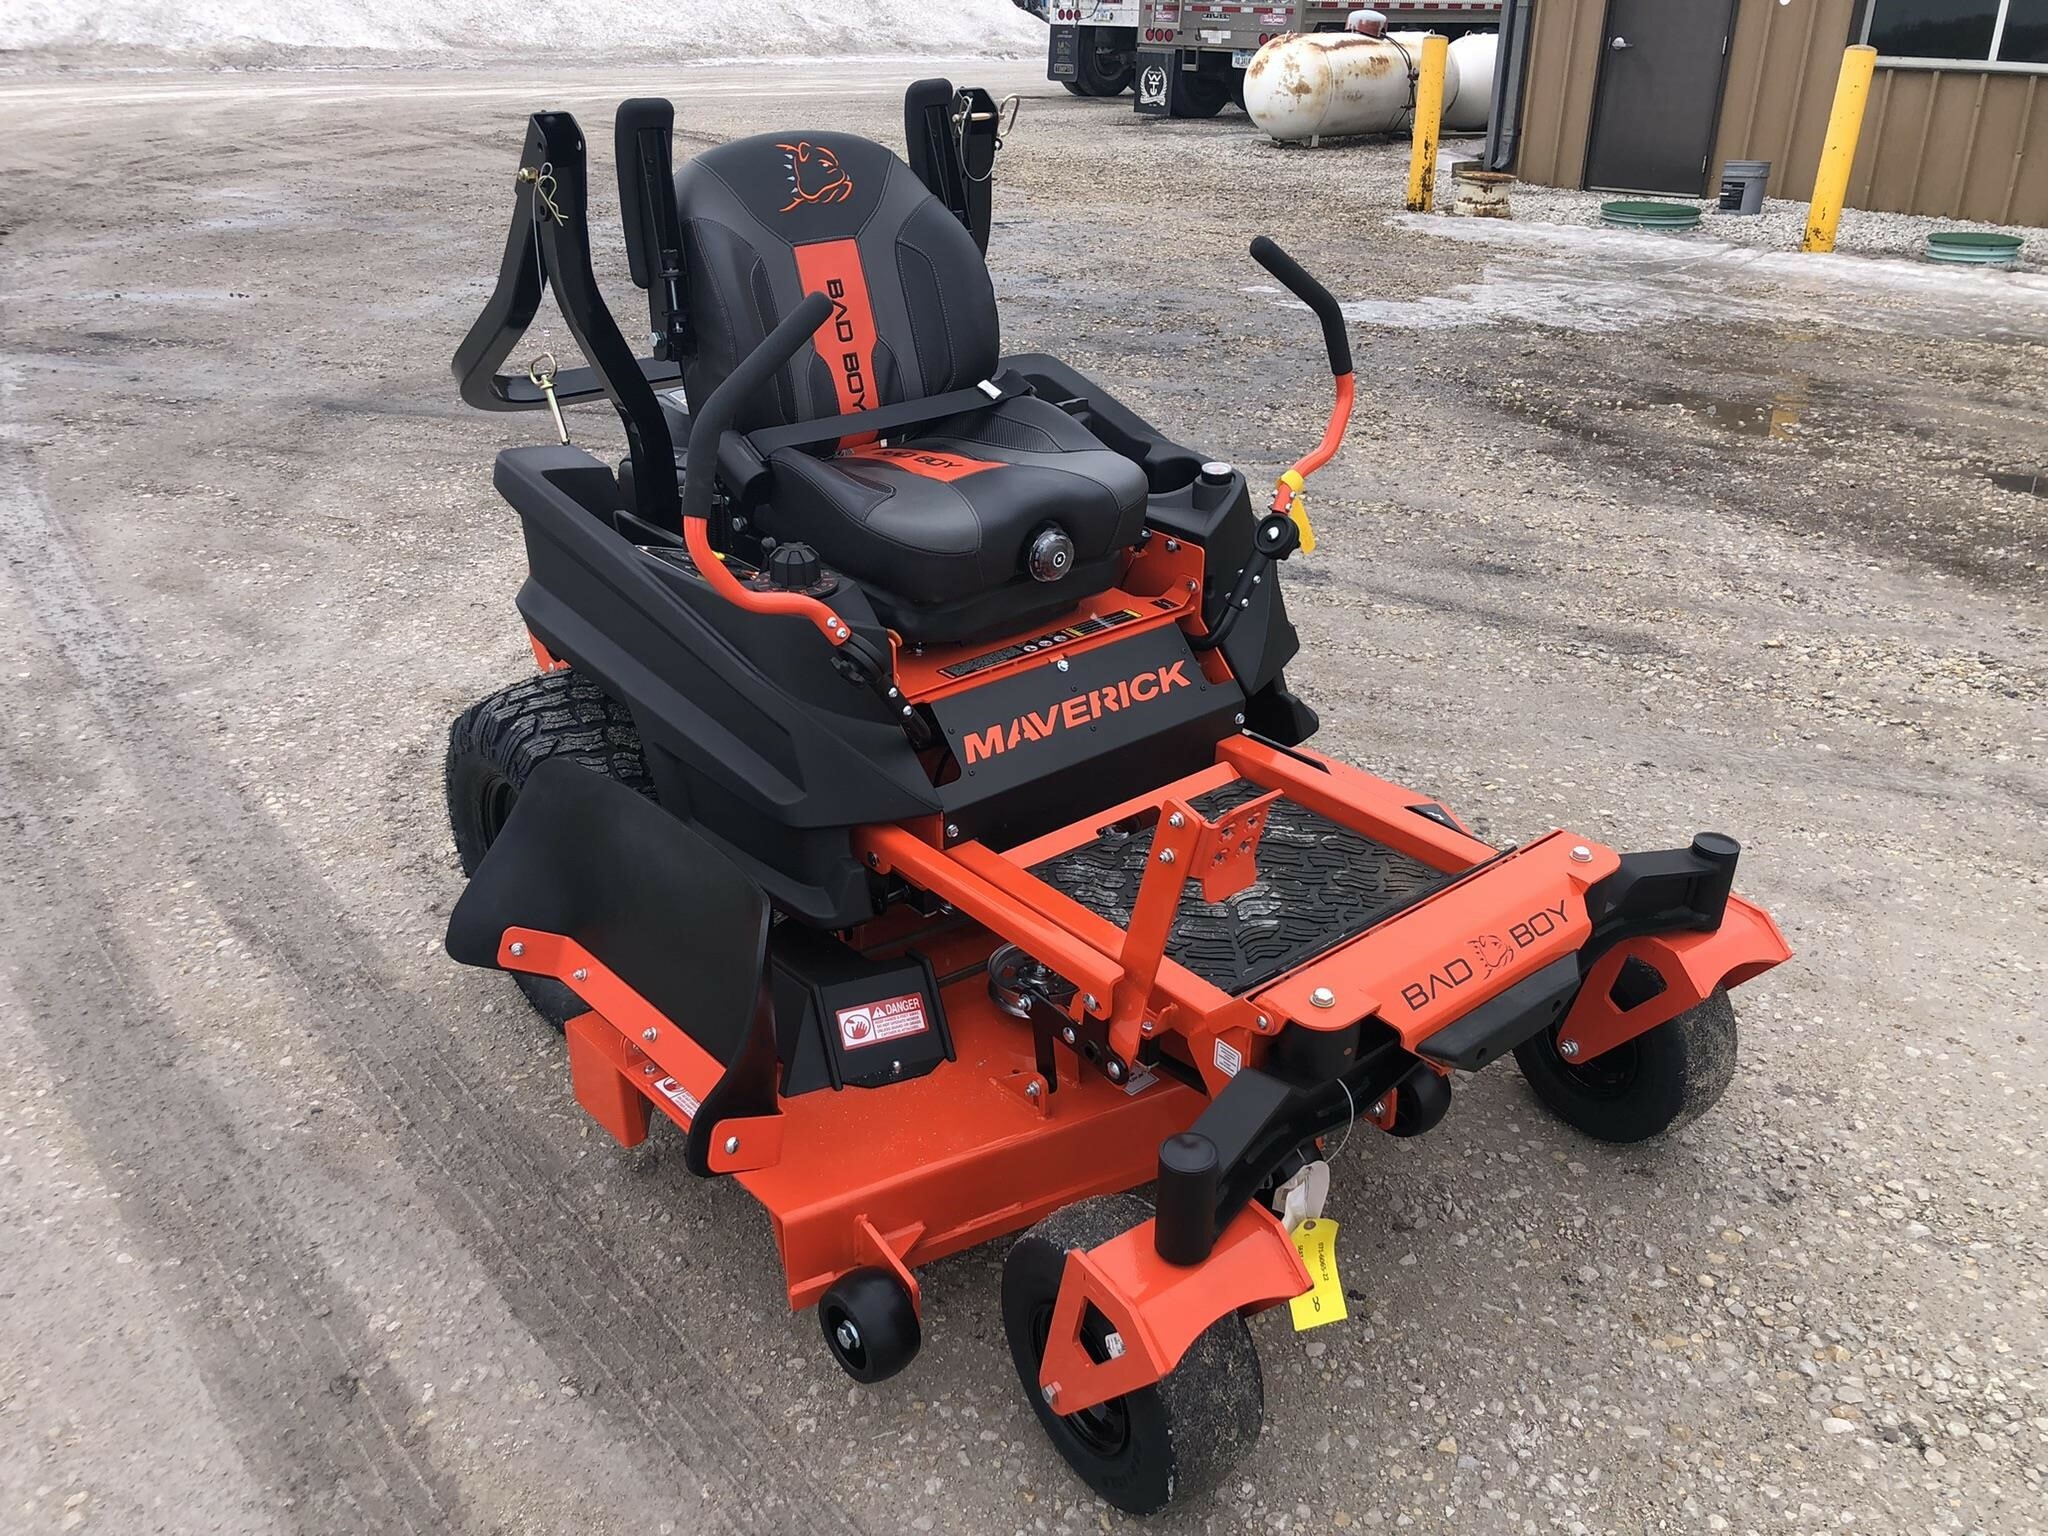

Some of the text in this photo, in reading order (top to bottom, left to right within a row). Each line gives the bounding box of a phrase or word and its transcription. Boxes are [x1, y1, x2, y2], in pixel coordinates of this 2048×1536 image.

[827, 278, 867, 412] BAD BOY
[913, 456, 964, 468] BOY
[962, 660, 1192, 766] MAVERICK
[884, 997, 921, 1015] DANGER
[1400, 899, 1570, 1012] BAD BOY
